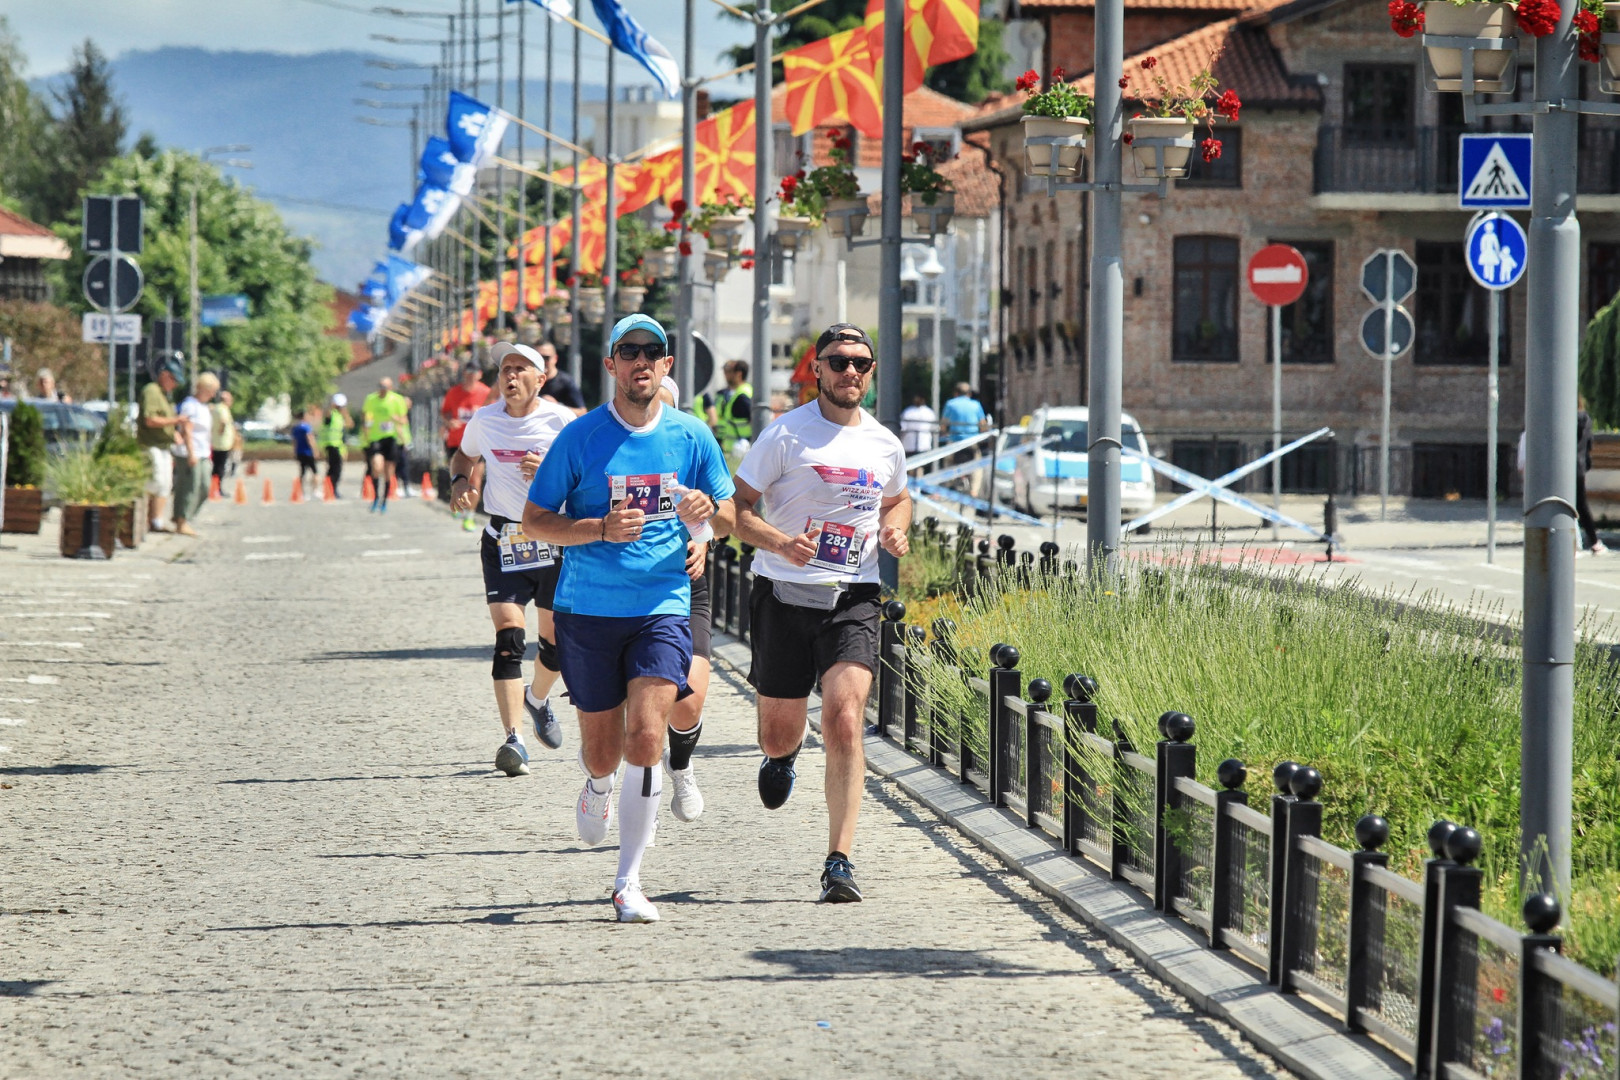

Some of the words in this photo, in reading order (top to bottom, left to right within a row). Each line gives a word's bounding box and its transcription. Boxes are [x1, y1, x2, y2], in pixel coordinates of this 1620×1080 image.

[636, 486, 651, 498] 79
[842, 486, 860, 494] WIZZ
[826, 534, 847, 547] 282
[515, 542, 533, 552] 506
